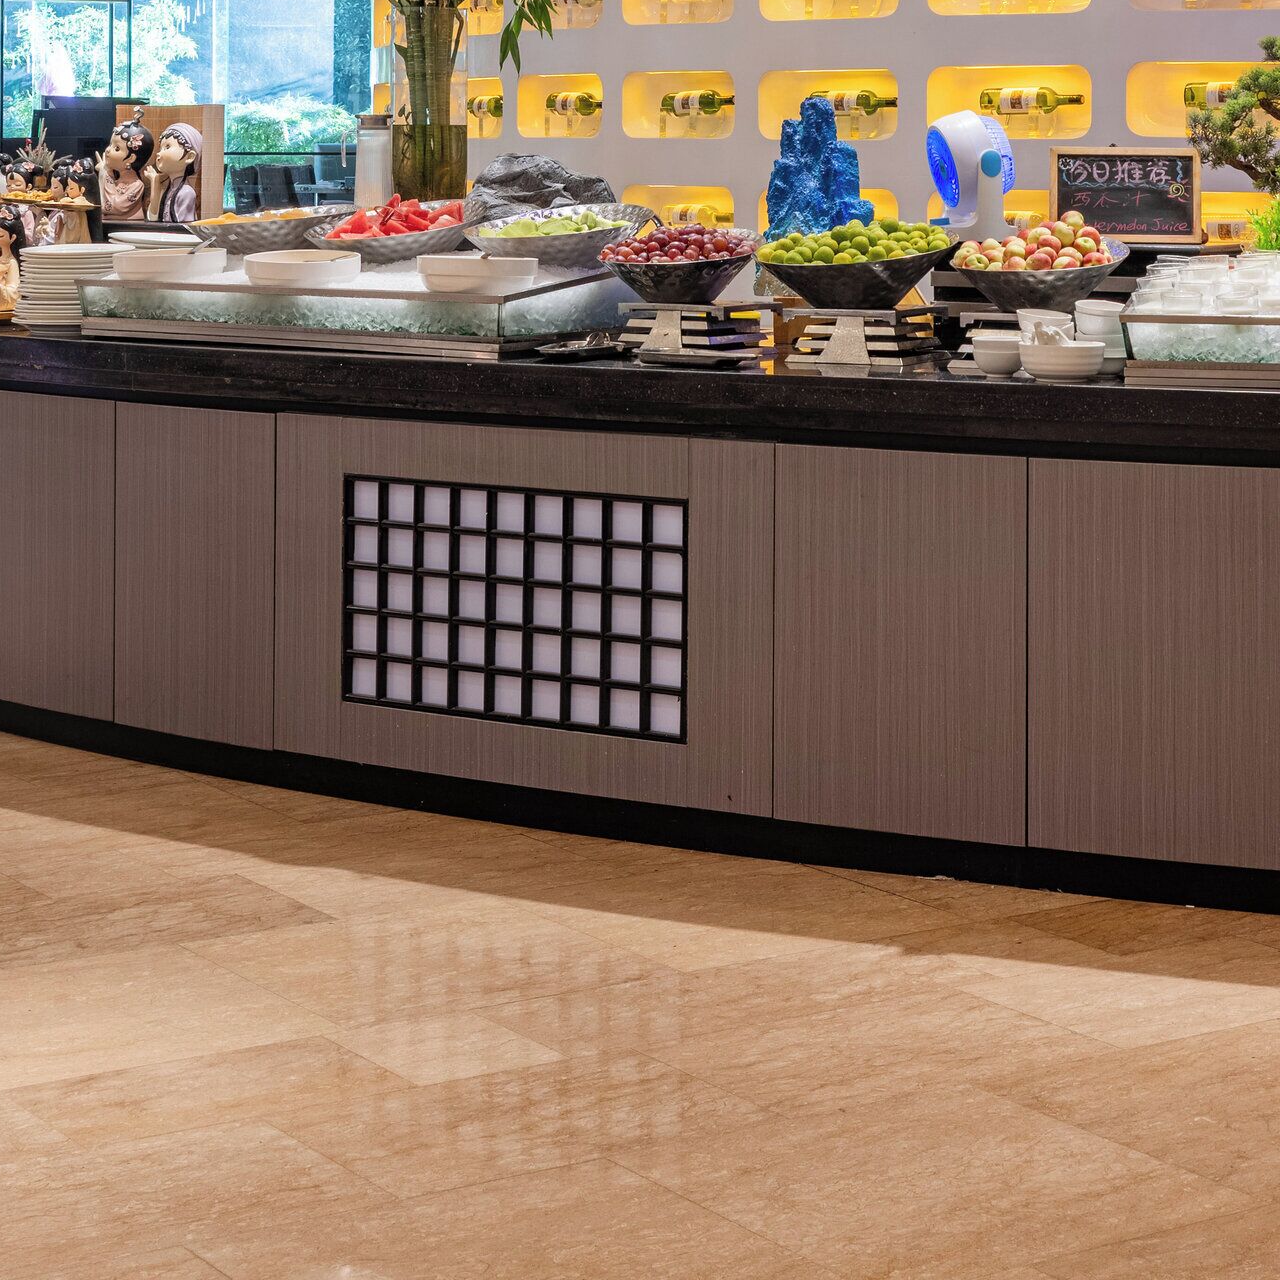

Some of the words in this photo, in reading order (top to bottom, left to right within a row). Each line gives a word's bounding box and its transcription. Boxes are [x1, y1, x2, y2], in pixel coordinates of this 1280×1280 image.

[1069, 158, 1172, 185] 今日推荐
[1089, 218, 1148, 232] termelon
[1151, 217, 1190, 232] Juice
